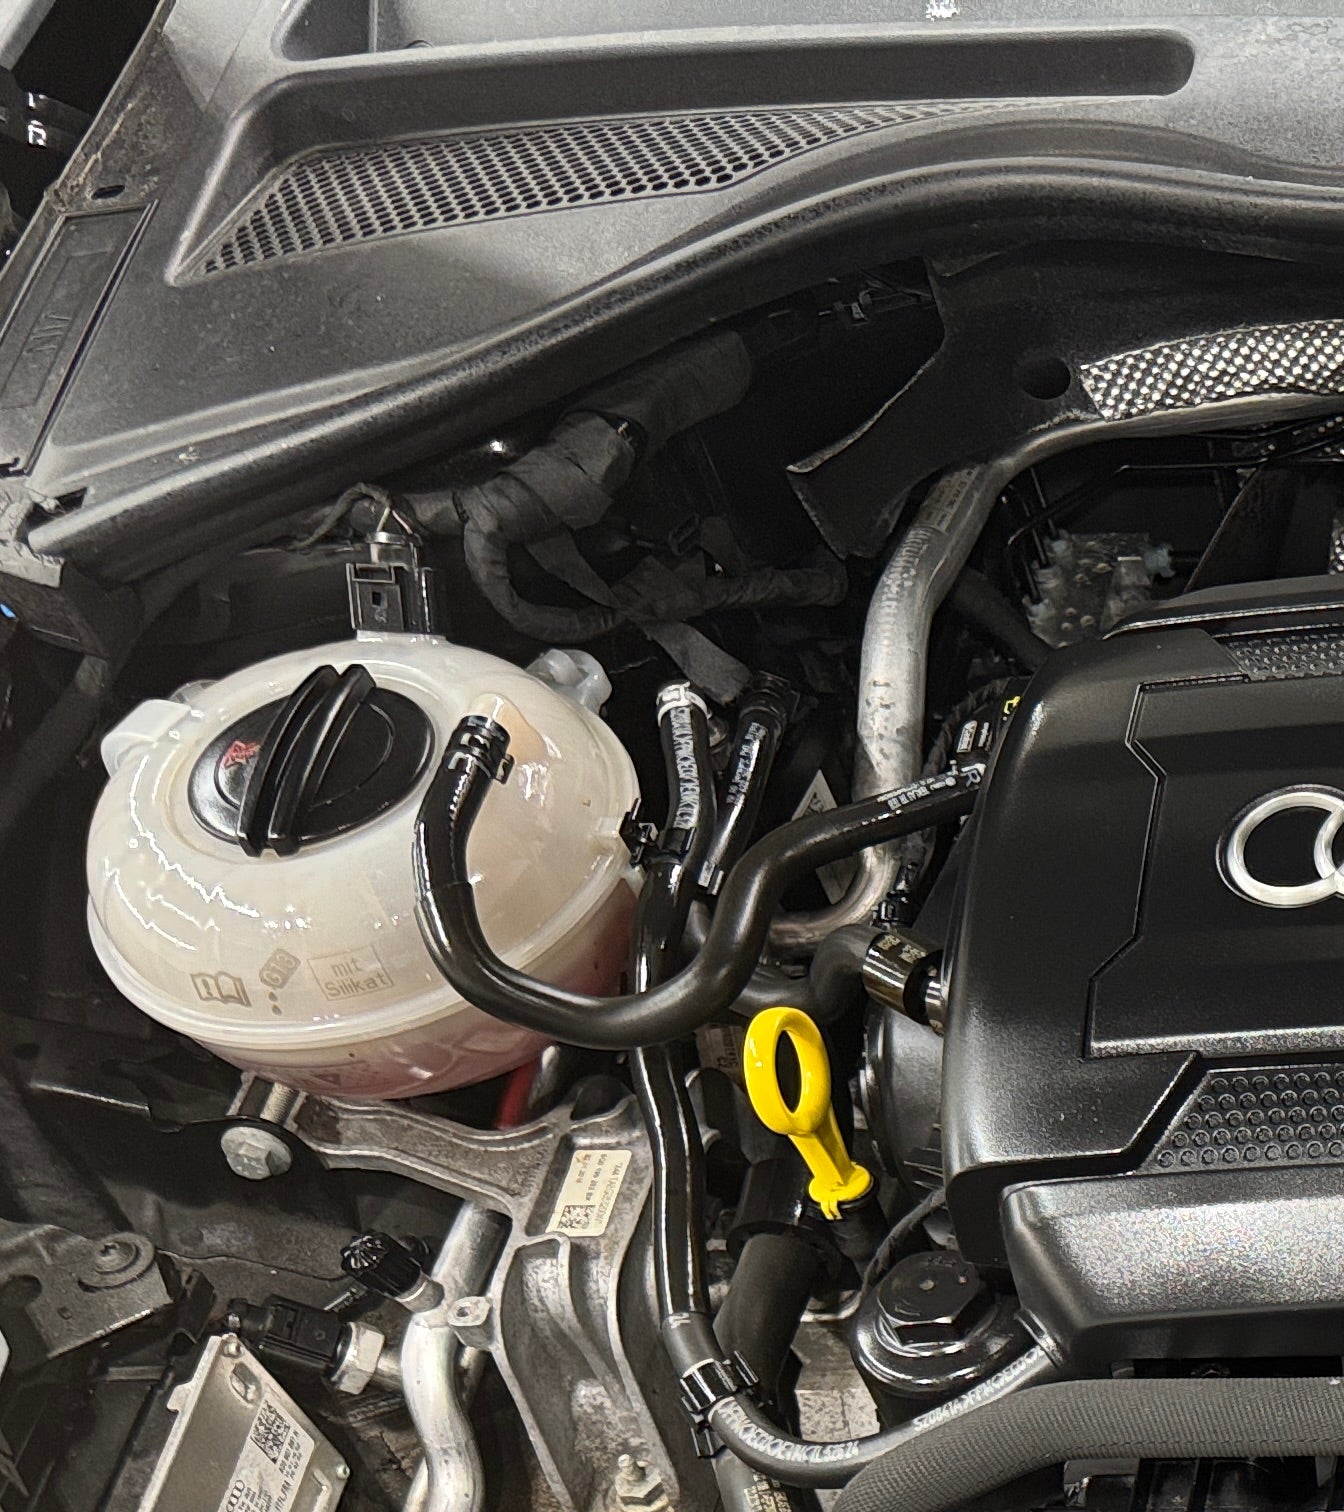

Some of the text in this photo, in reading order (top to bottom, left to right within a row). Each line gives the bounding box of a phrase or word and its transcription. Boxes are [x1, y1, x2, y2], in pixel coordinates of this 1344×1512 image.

[263, 952, 297, 985] G13
[331, 958, 361, 977] mit
[325, 972, 388, 998] Silikat
